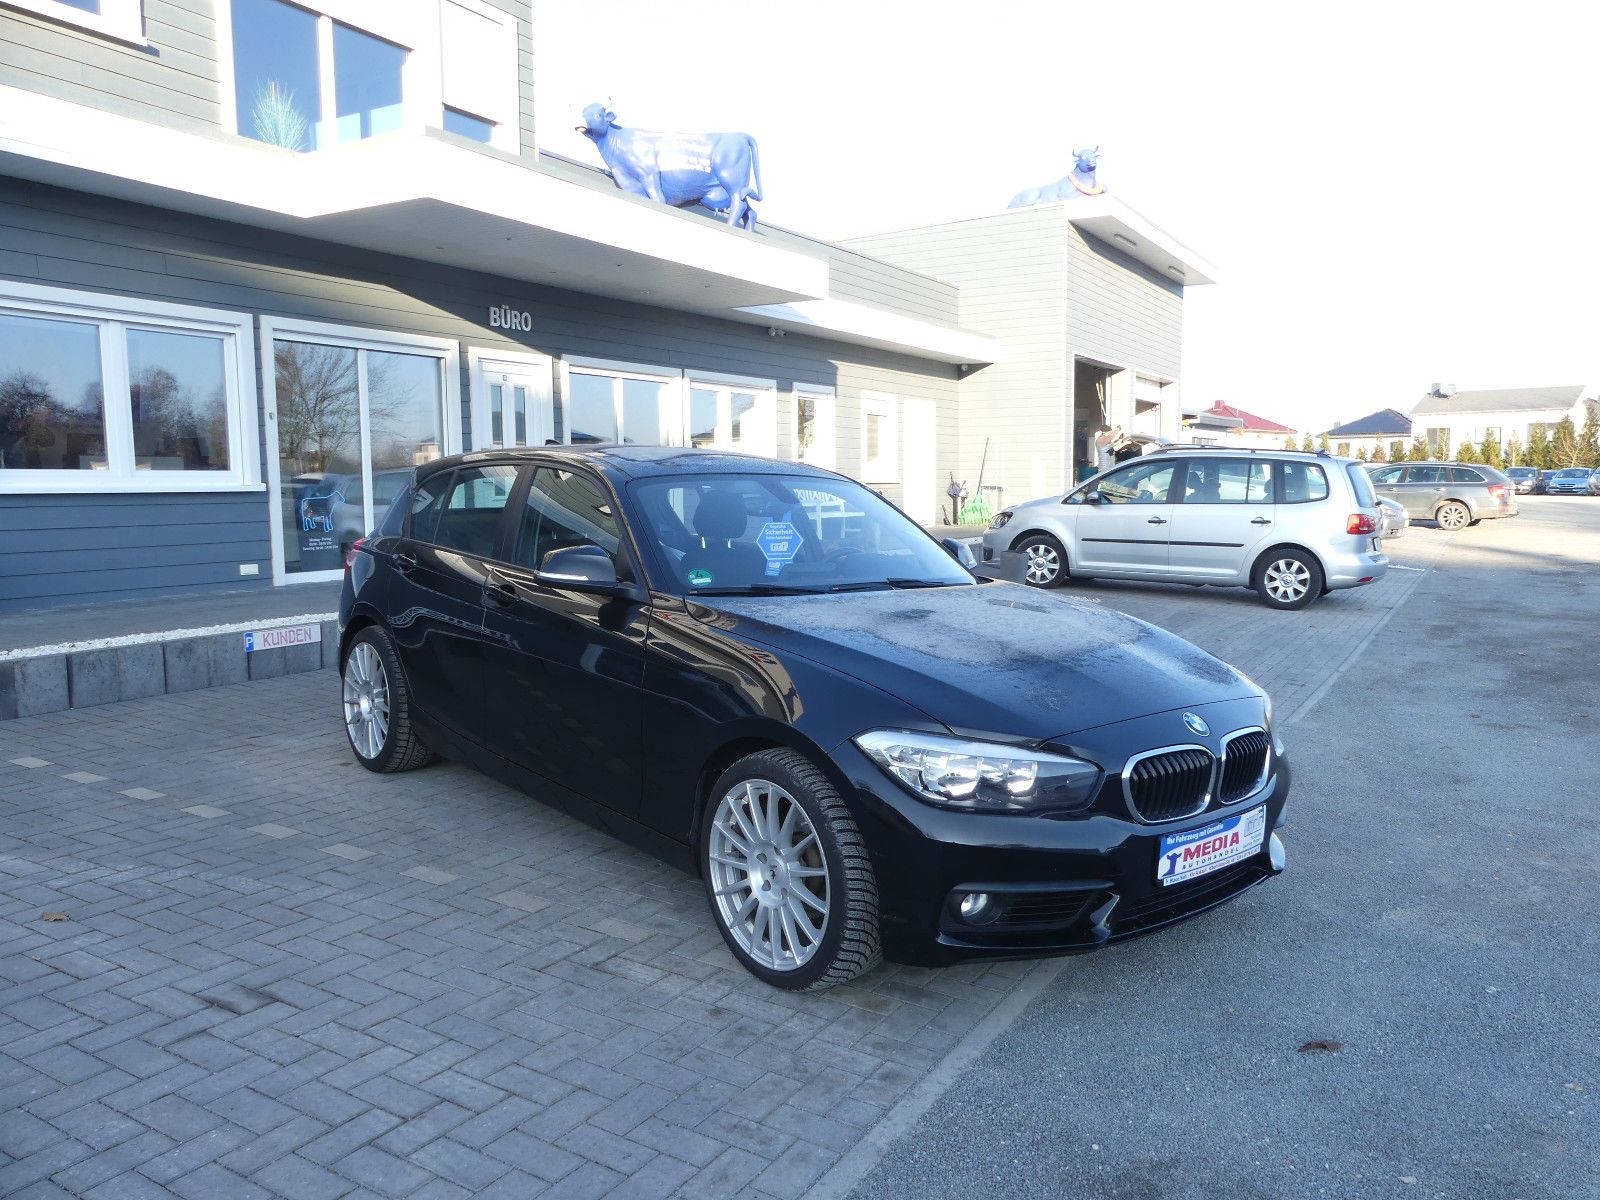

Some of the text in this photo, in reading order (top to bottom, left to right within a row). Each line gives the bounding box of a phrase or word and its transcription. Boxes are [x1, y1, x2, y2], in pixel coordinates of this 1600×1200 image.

[489, 304, 532, 332] BÜRO
[262, 628, 312, 647] KUNDEN
[1166, 836, 1175, 844] Ihr
[1176, 833, 1198, 843] Fahrzeug
[1183, 832, 1239, 862] MEDIA
[1181, 848, 1239, 870] AUTOHANDEL
